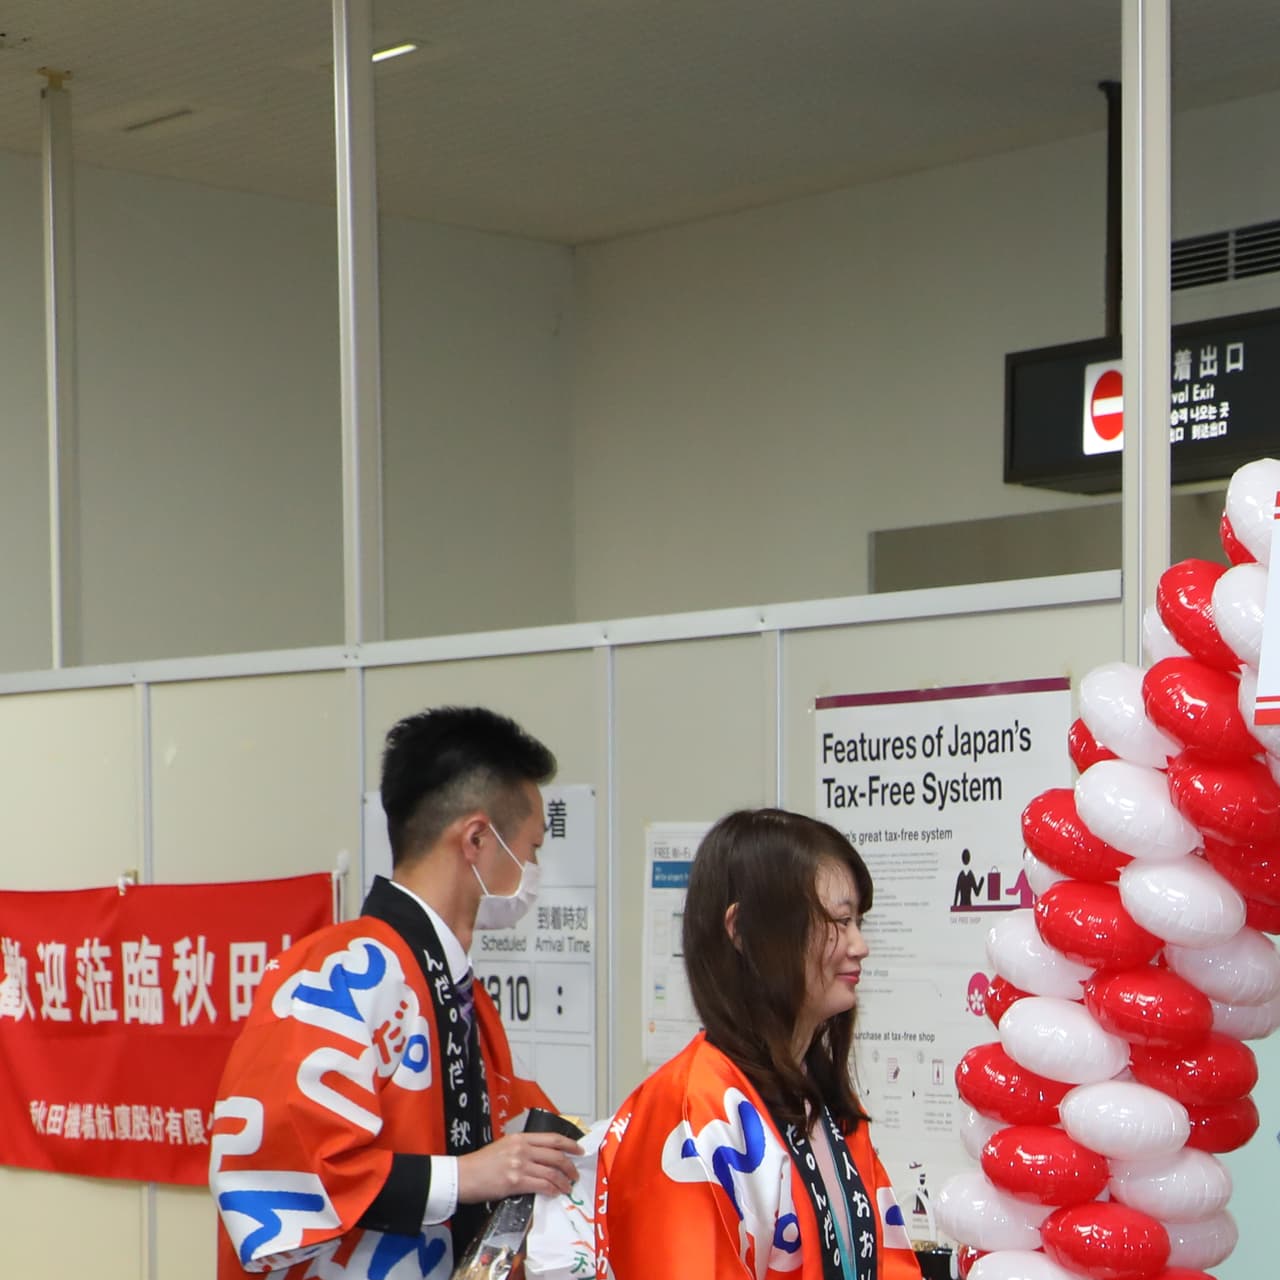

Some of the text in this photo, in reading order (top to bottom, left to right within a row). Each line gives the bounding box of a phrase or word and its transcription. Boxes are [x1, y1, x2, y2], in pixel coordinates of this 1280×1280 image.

[1193, 383, 1215, 402] Exit
[822, 733, 917, 764] Features
[922, 726, 944, 758] of
[822, 771, 1002, 811] Tax-Free System
[859, 831, 882, 845] great
[884, 829, 919, 842] tax-free
[921, 829, 953, 843] system
[537, 906, 589, 930] 到着時刻
[481, 935, 591, 953] Scheduled Arrival Time
[0, 934, 291, 1027] 歡迎蒞臨秋田
[854, 1032, 882, 1041] urchase
